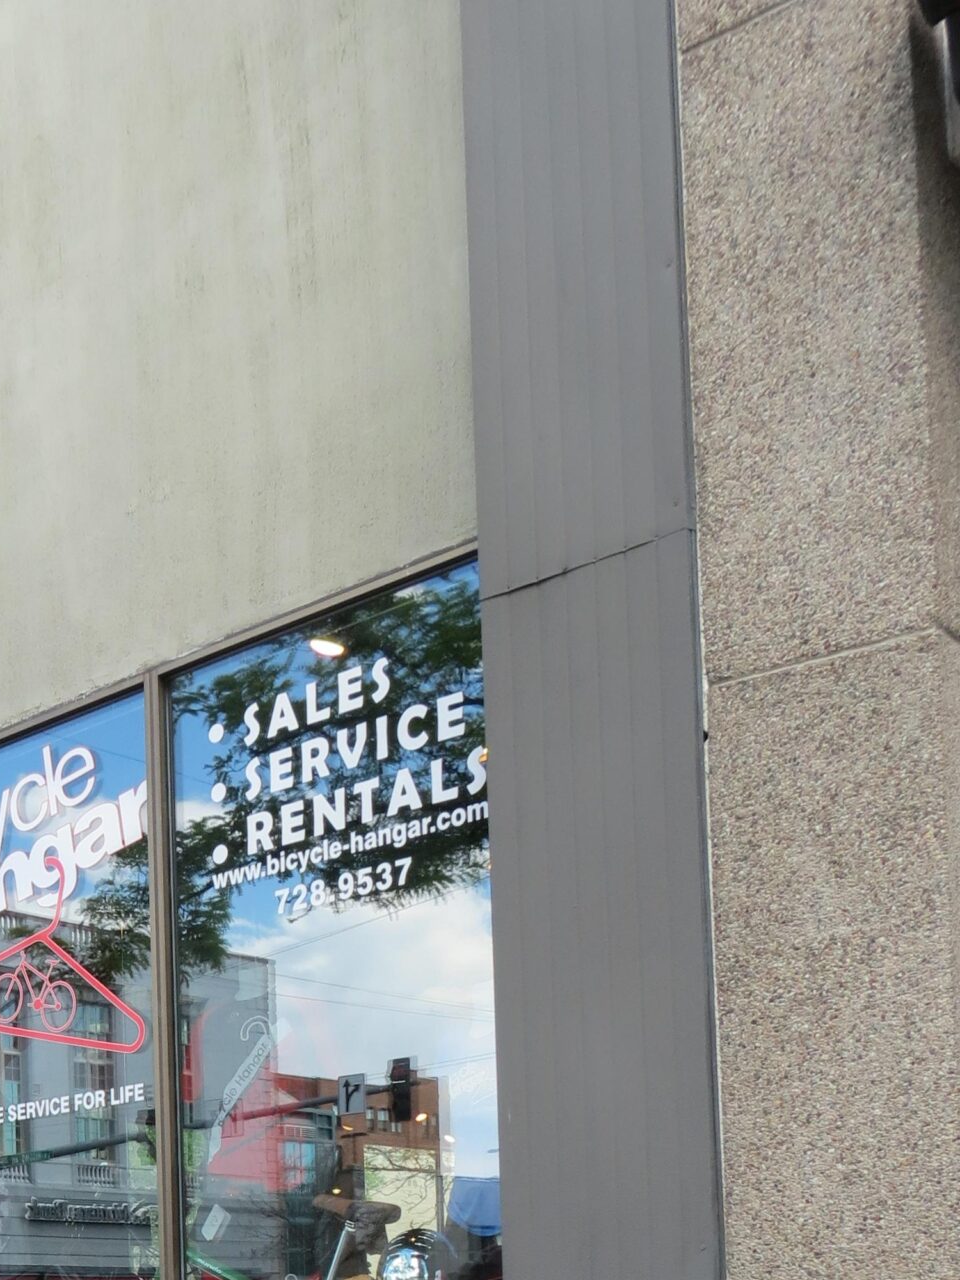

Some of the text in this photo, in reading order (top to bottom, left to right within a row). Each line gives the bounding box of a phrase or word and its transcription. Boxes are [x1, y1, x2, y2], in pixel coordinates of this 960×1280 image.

[243, 657, 390, 746] SALES
[245, 691, 466, 801] SERVICE
[246, 746, 488, 855] RENTALS
[212, 802, 488, 889] www.bicycle-hangar.com
[7, 1096, 70, 1122] SERVICE
[74, 1090, 106, 1111] FOR
[110, 1083, 145, 1105] LIFE
